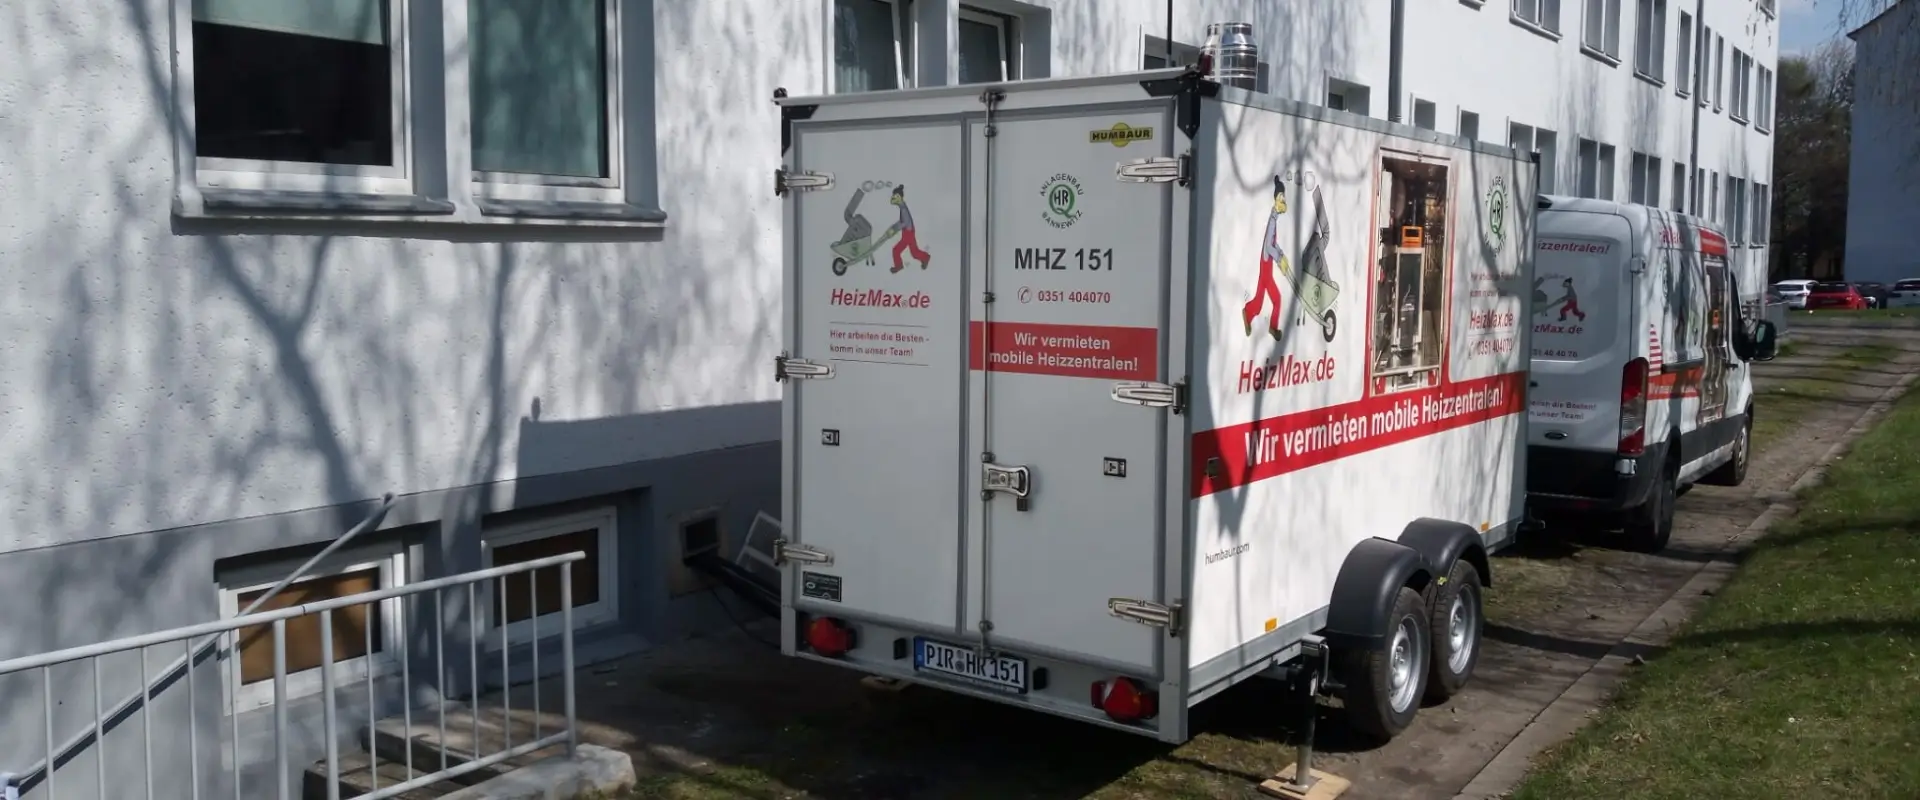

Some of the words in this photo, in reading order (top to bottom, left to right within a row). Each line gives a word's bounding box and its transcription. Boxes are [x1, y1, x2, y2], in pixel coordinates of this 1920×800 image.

[1092, 129, 1150, 141] HUMBAUR
[1040, 173, 1084, 196] ANLAGENBAU
[1053, 190, 1069, 205] HR
[1041, 210, 1083, 229] BANNEWITZ
[1537, 241, 1611, 255] izzentralen!
[1014, 248, 1066, 270] MHZ
[1075, 248, 1113, 270] 151
[1038, 290, 1064, 302] 0351
[1069, 291, 1111, 303] 404070
[830, 329, 846, 339] Hier
[848, 331, 879, 341] arbeiten
[881, 333, 893, 341] die
[895, 333, 924, 342] Besten
[1534, 324, 1584, 335] zMaxde
[830, 344, 854, 354] komm
[856, 346, 863, 354] in
[890, 347, 914, 356] Team!
[1014, 332, 1038, 346] Wir
[1041, 335, 1110, 350] vermieten
[989, 351, 1034, 365] mobile
[1038, 353, 1138, 371] Heizzentralen!
[1245, 427, 1279, 467] Wir
[1284, 413, 1367, 457] vermieten
[1372, 398, 1419, 436] mobile
[1422, 380, 1504, 424] Heizzentralen!
[1205, 543, 1250, 566] humbaur.com
[926, 644, 954, 669] PIR
[990, 659, 1020, 684] 151
